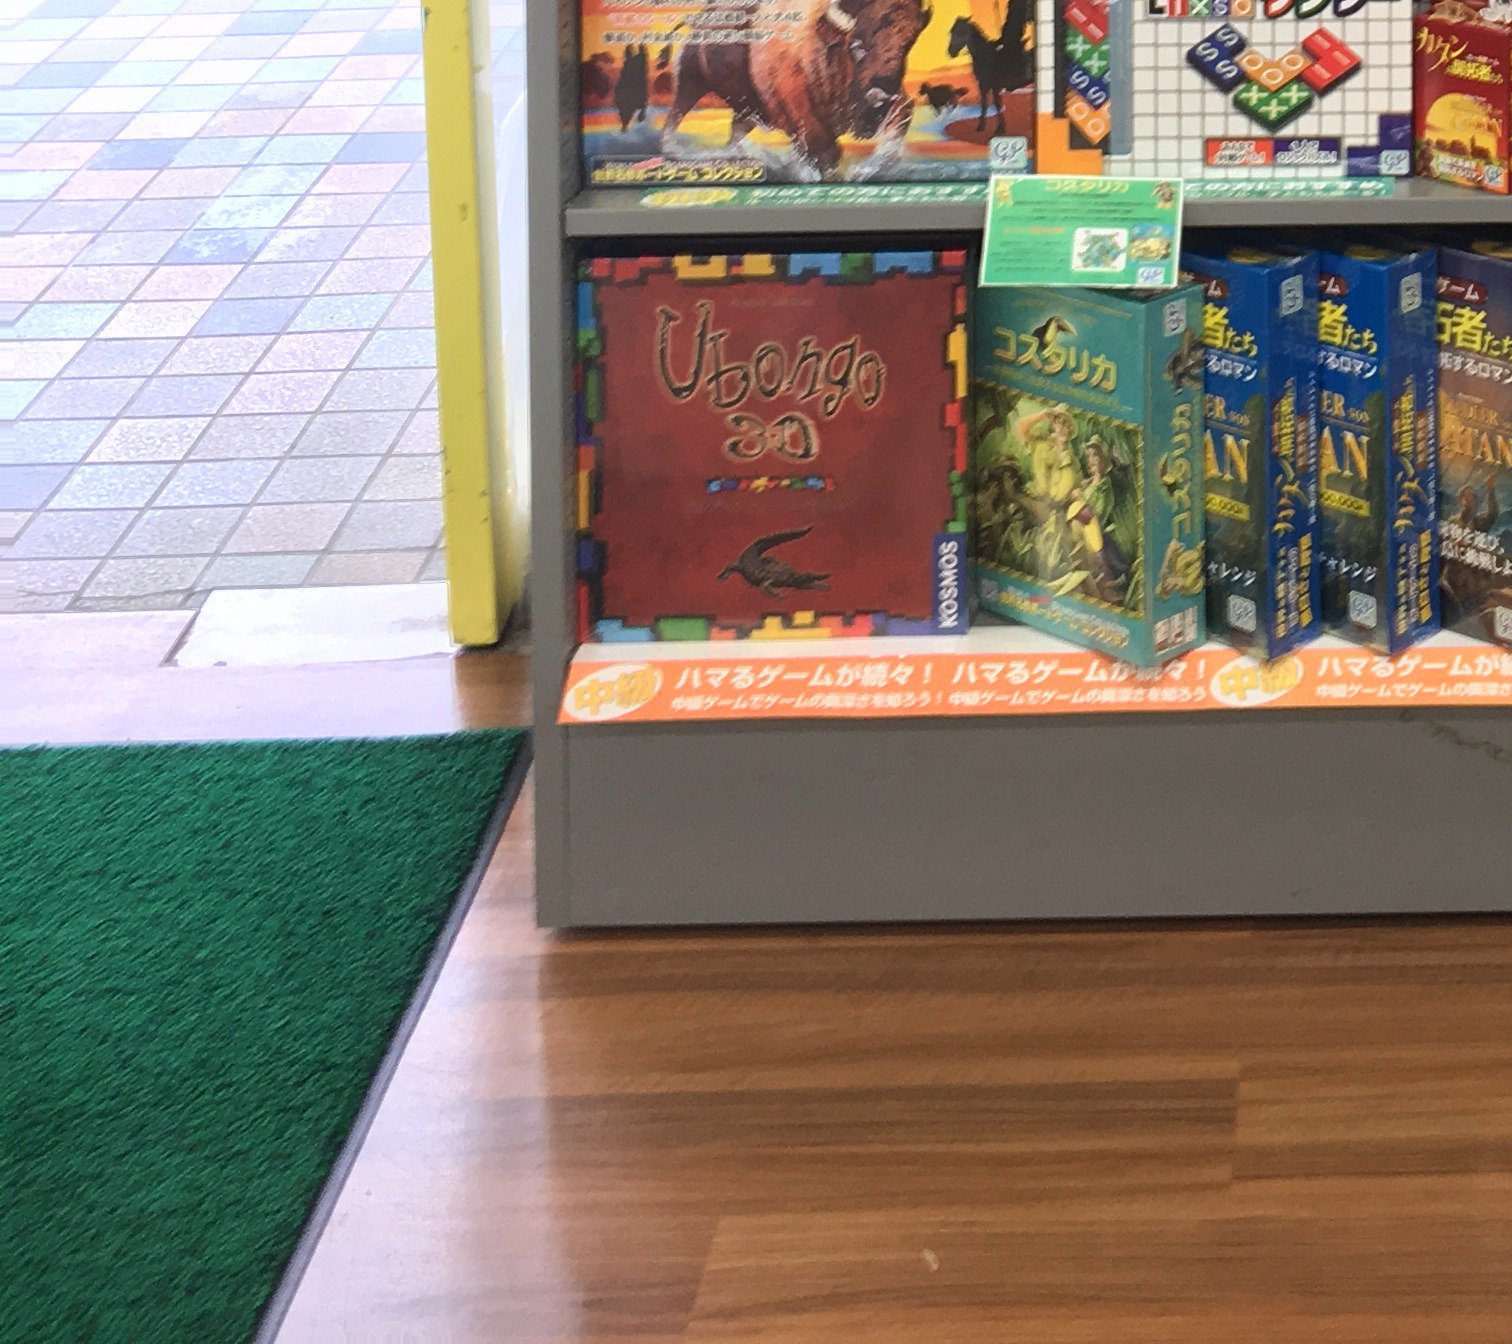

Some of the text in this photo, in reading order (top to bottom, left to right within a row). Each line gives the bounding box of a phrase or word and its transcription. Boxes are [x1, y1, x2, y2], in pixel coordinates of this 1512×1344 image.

[655, 297, 888, 419] Ubongo
[994, 325, 1118, 394] コスタリカ
[936, 539, 960, 629] KOSMOS
[676, 661, 933, 690] ハマるゲームが続々!
